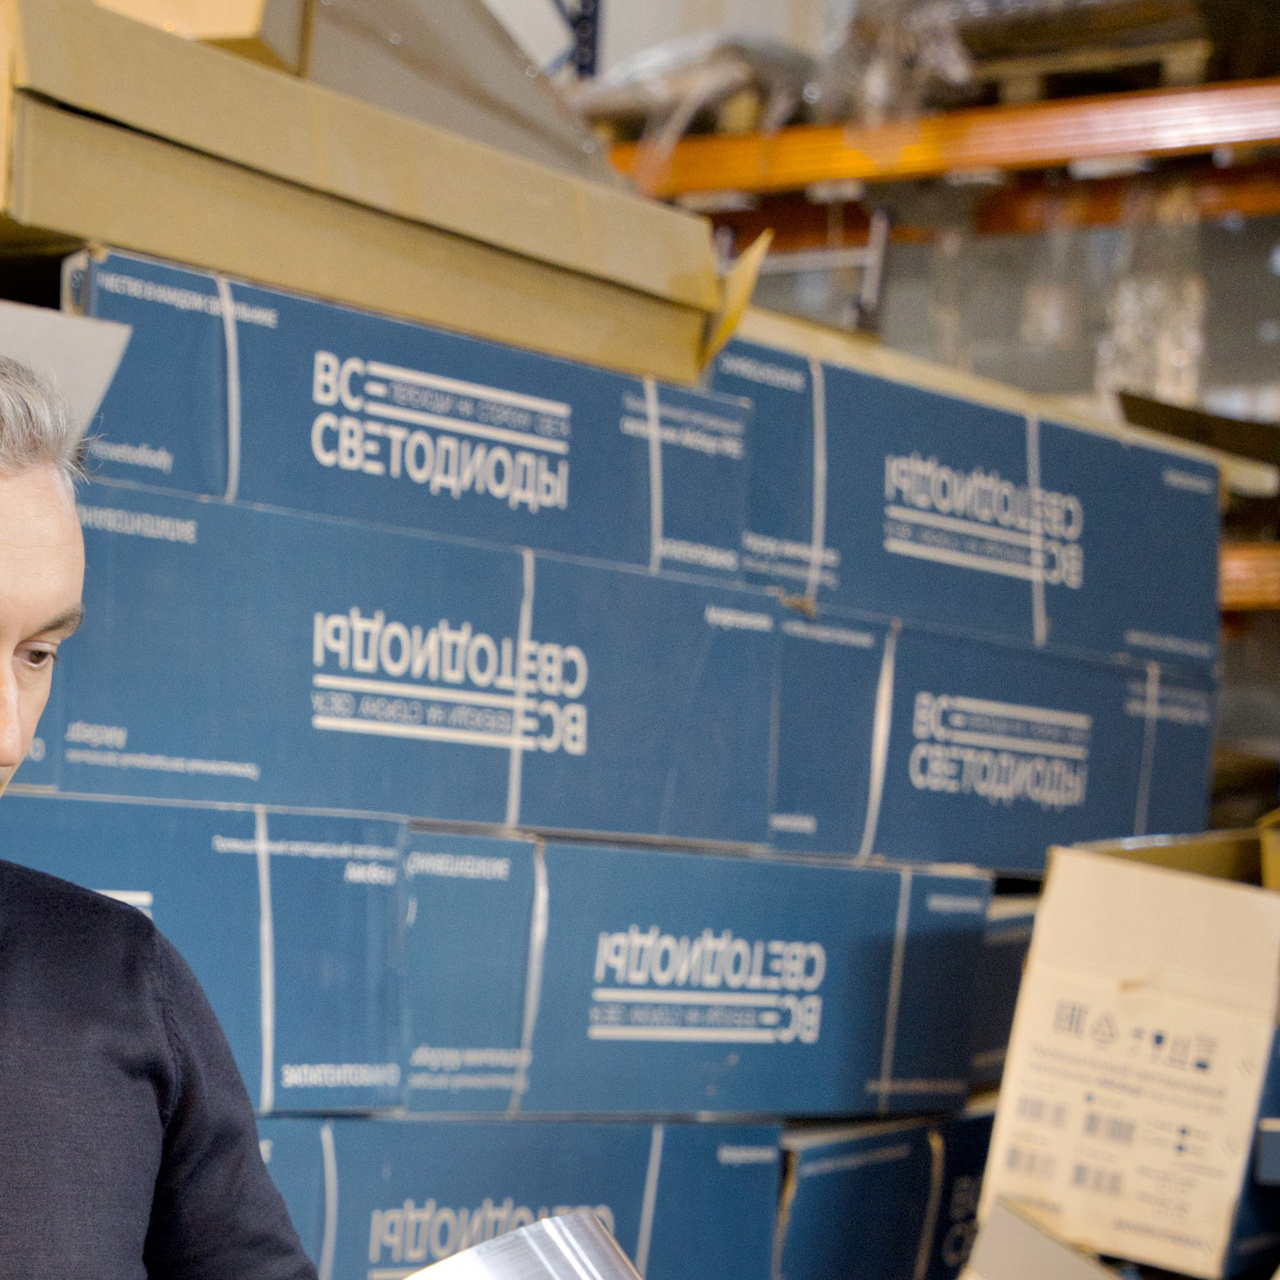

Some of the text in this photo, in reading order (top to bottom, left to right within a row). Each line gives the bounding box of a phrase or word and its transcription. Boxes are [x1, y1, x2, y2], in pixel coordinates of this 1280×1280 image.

[311, 412, 569, 514] СВЕТОДИОДЫ
[313, 606, 588, 699] СВЕТОДИОДЫ
[594, 923, 827, 991] СВЕТОДИОДЫ
